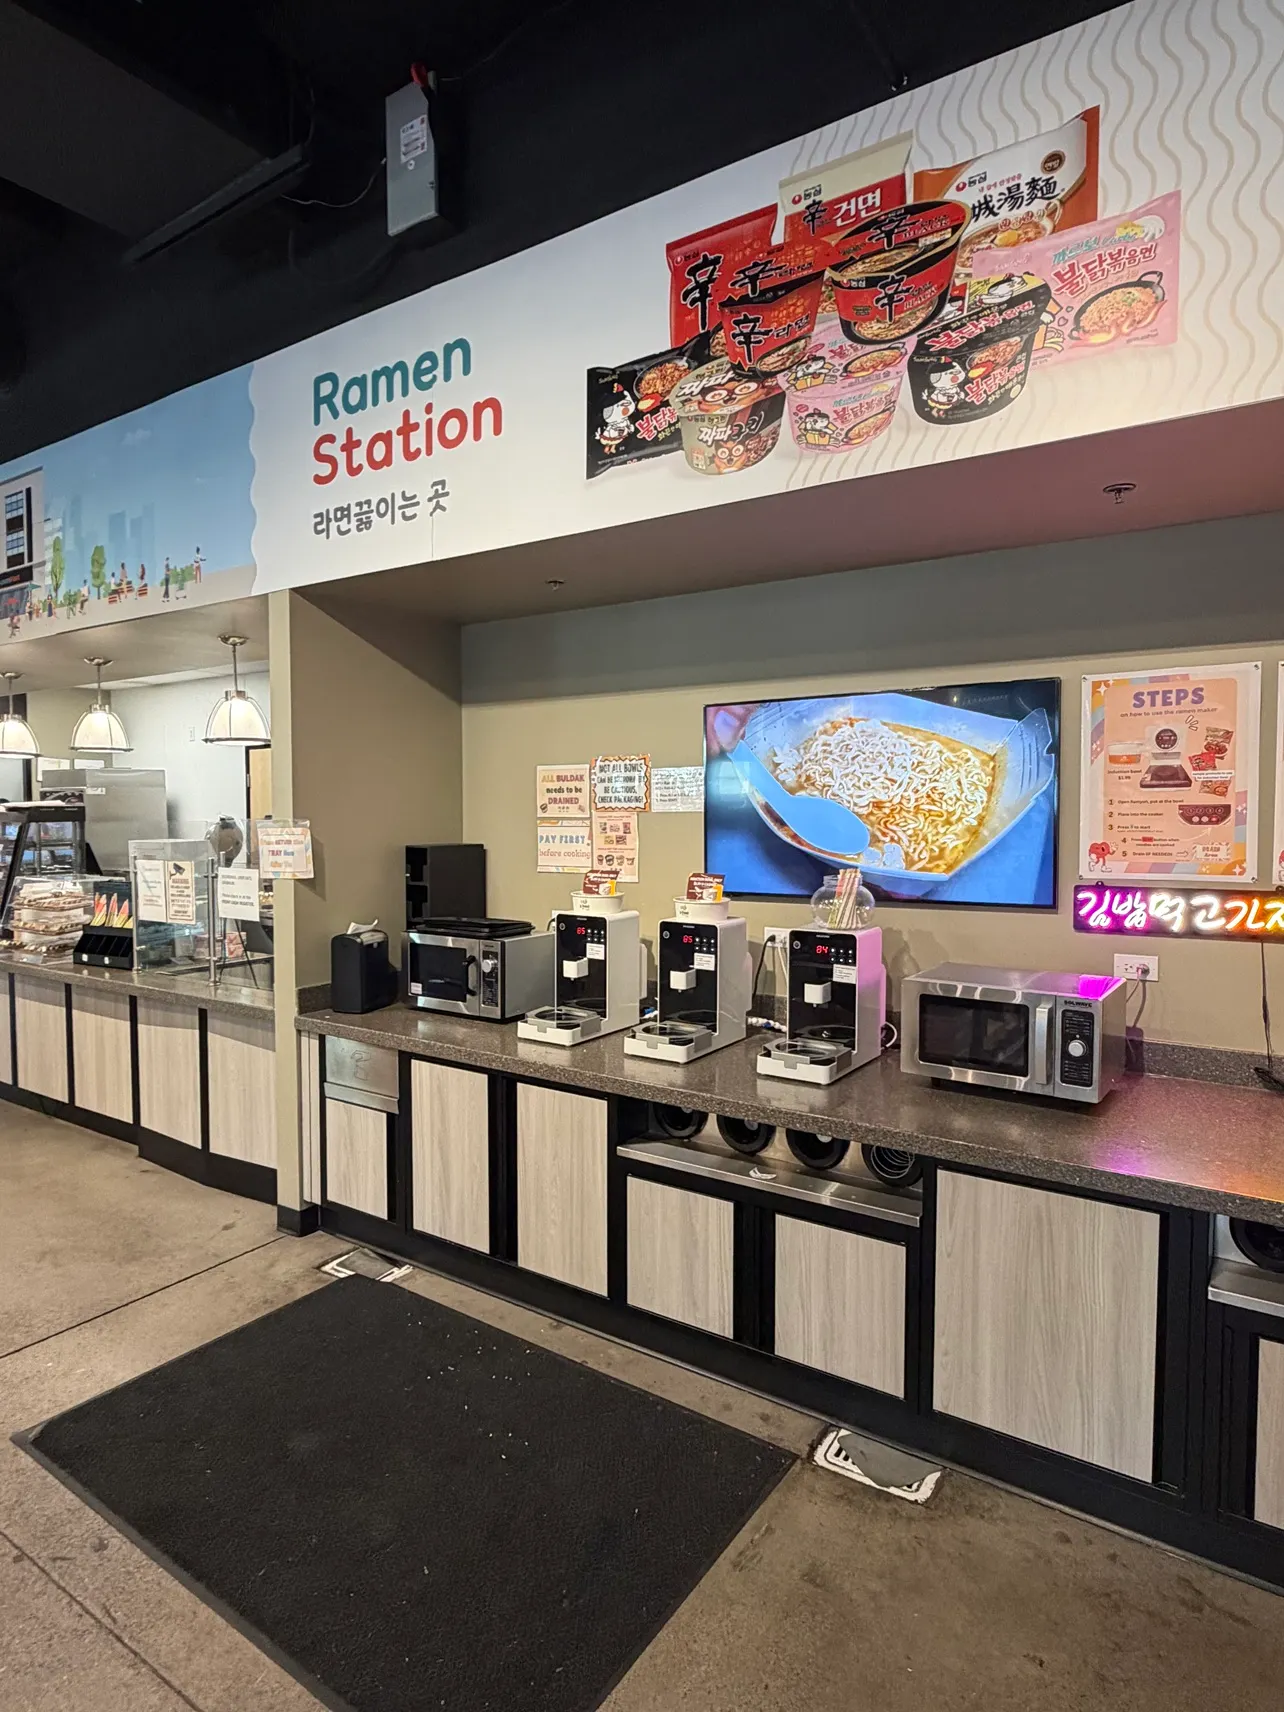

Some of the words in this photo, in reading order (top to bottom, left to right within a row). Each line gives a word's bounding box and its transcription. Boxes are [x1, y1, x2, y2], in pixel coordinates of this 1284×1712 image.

[803, 199, 828, 236] 辛
[834, 188, 881, 227] 건면
[866, 216, 920, 248] 辛
[729, 260, 787, 297] 辛
[1052, 243, 1157, 298] 불닭볶음면
[682, 252, 722, 331] 辛
[874, 273, 914, 323] 辛
[731, 313, 774, 363] 辛
[313, 337, 471, 427] Ramen
[676, 370, 746, 398] 짜파
[313, 397, 502, 485] Station
[313, 490, 421, 540] 라면끓이는
[427, 479, 450, 517] 곳
[1132, 687, 1205, 709] STEPS
[541, 774, 555, 783] ALL
[556, 774, 585, 783] BULDAK
[546, 786, 564, 794] needs
[548, 797, 579, 805] DRAINED
[268, 849, 282, 857] TRAY
[539, 835, 556, 844] PAY
[560, 835, 585, 845] FIRST
[539, 849, 561, 857] before
[563, 849, 591, 860] cooking
[1063, 1000, 1093, 1008] SOLWAVE
